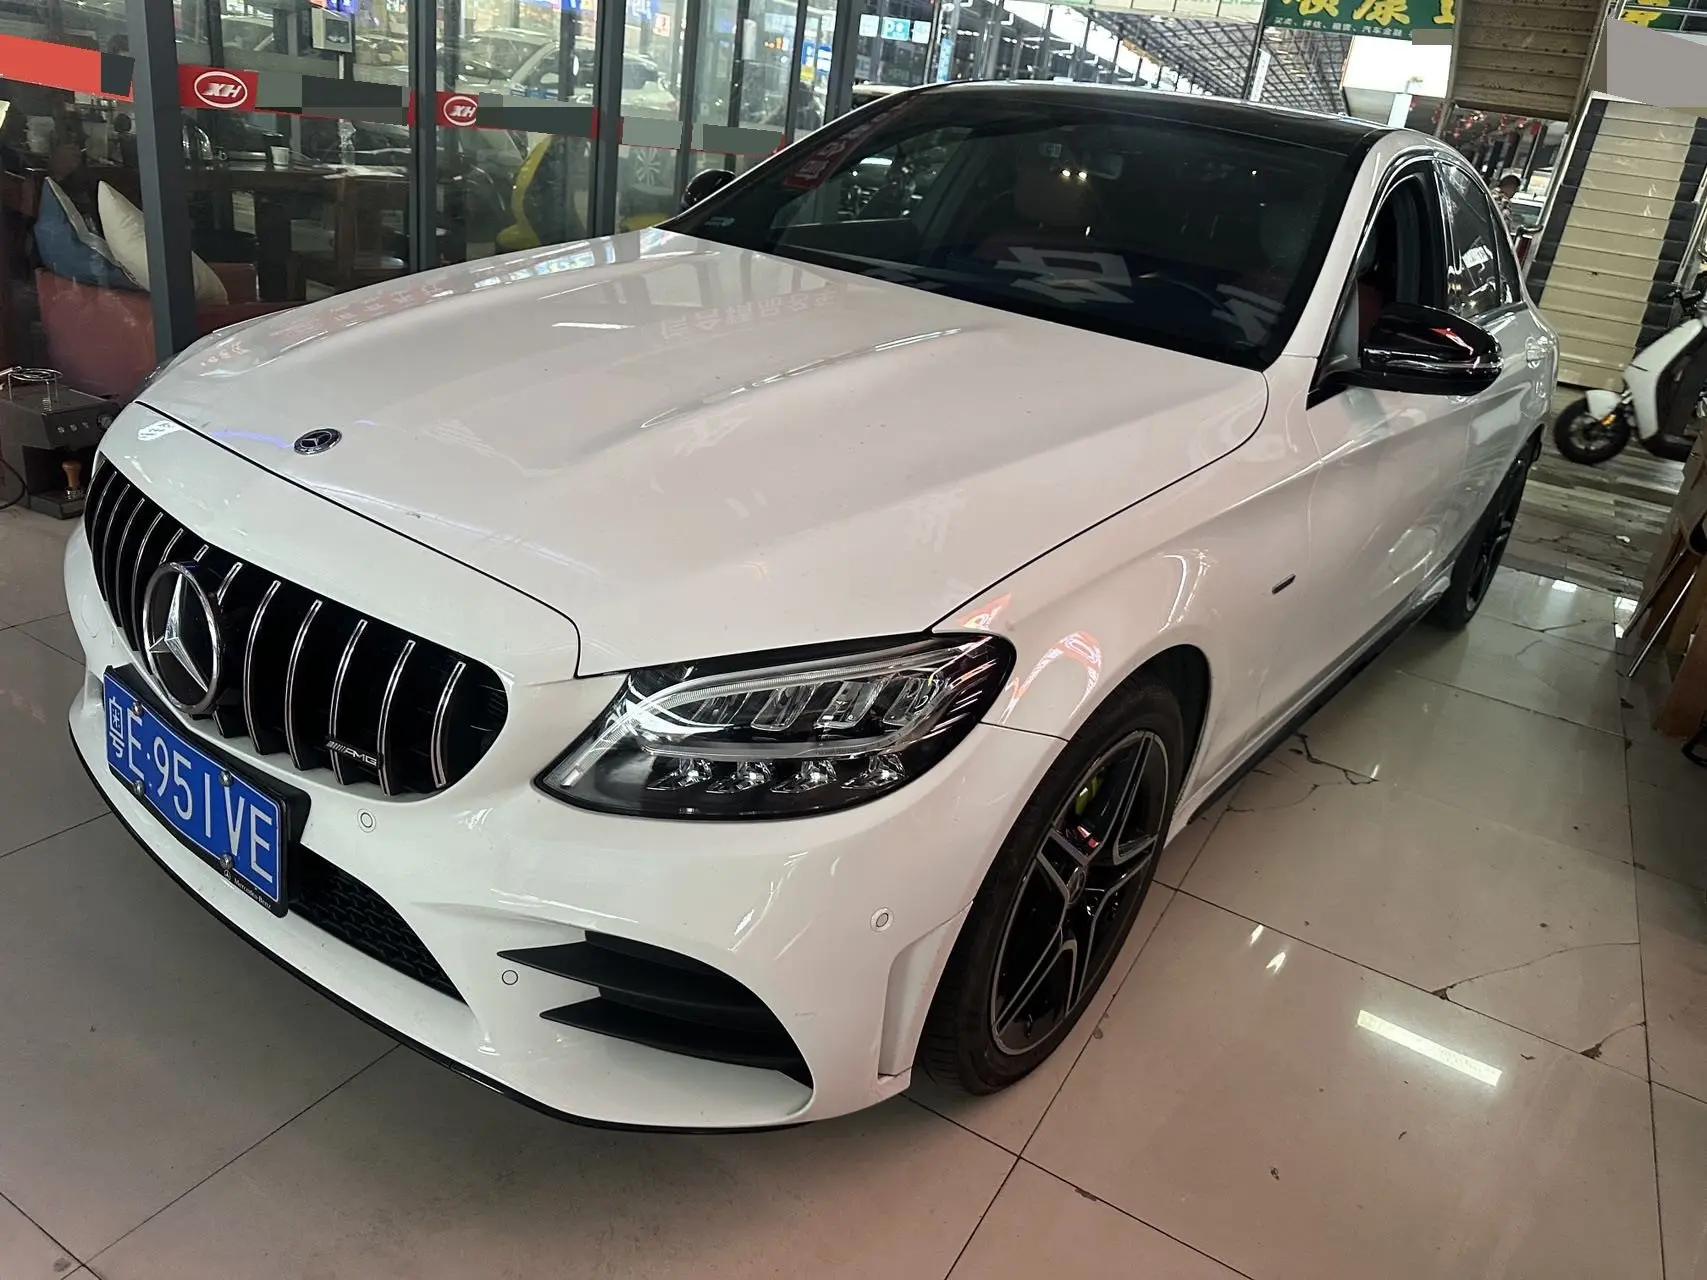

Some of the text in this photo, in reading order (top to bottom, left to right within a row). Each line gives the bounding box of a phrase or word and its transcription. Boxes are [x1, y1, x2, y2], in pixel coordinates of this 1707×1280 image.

[202, 82, 243, 99] XH
[449, 104, 478, 119] XH
[341, 746, 377, 767] AMG
